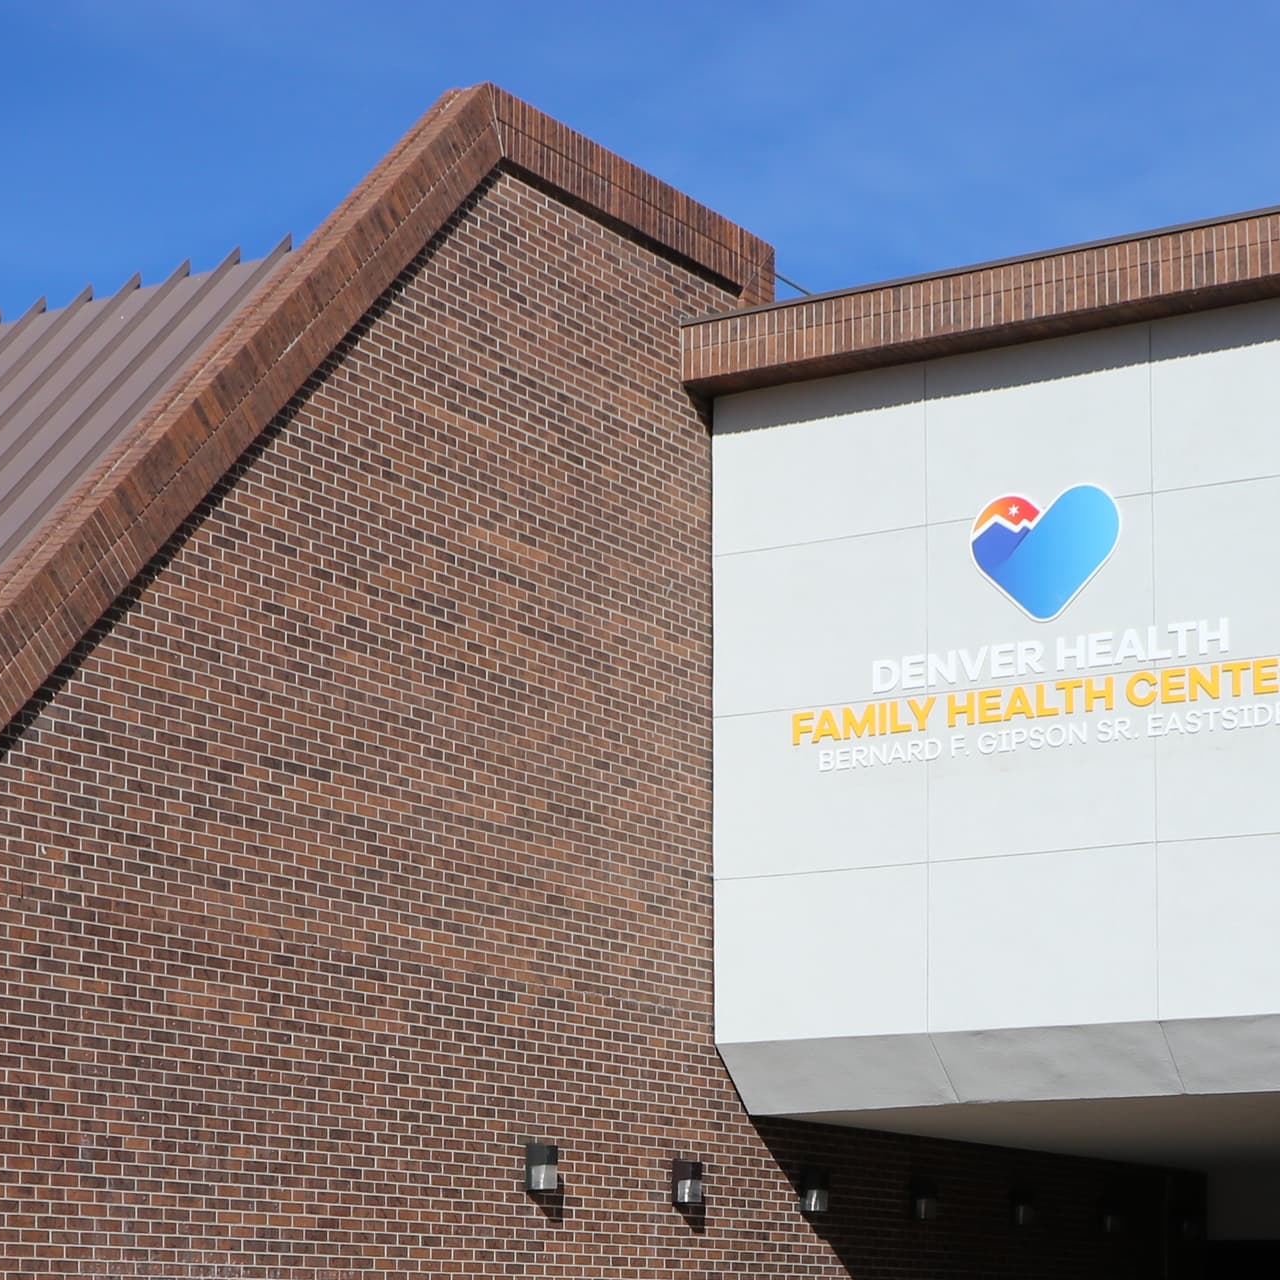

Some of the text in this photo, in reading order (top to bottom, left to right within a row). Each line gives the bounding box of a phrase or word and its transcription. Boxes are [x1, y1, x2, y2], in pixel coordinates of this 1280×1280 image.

[872, 617, 1229, 694] DENVER HEALTH
[791, 696, 936, 746] FAMILY
[947, 676, 1114, 728] HEALTH
[818, 737, 941, 772] BERNARD
[950, 735, 970, 758] F.
[977, 721, 1088, 755] GIPSON
[1096, 717, 1140, 743] SR.
